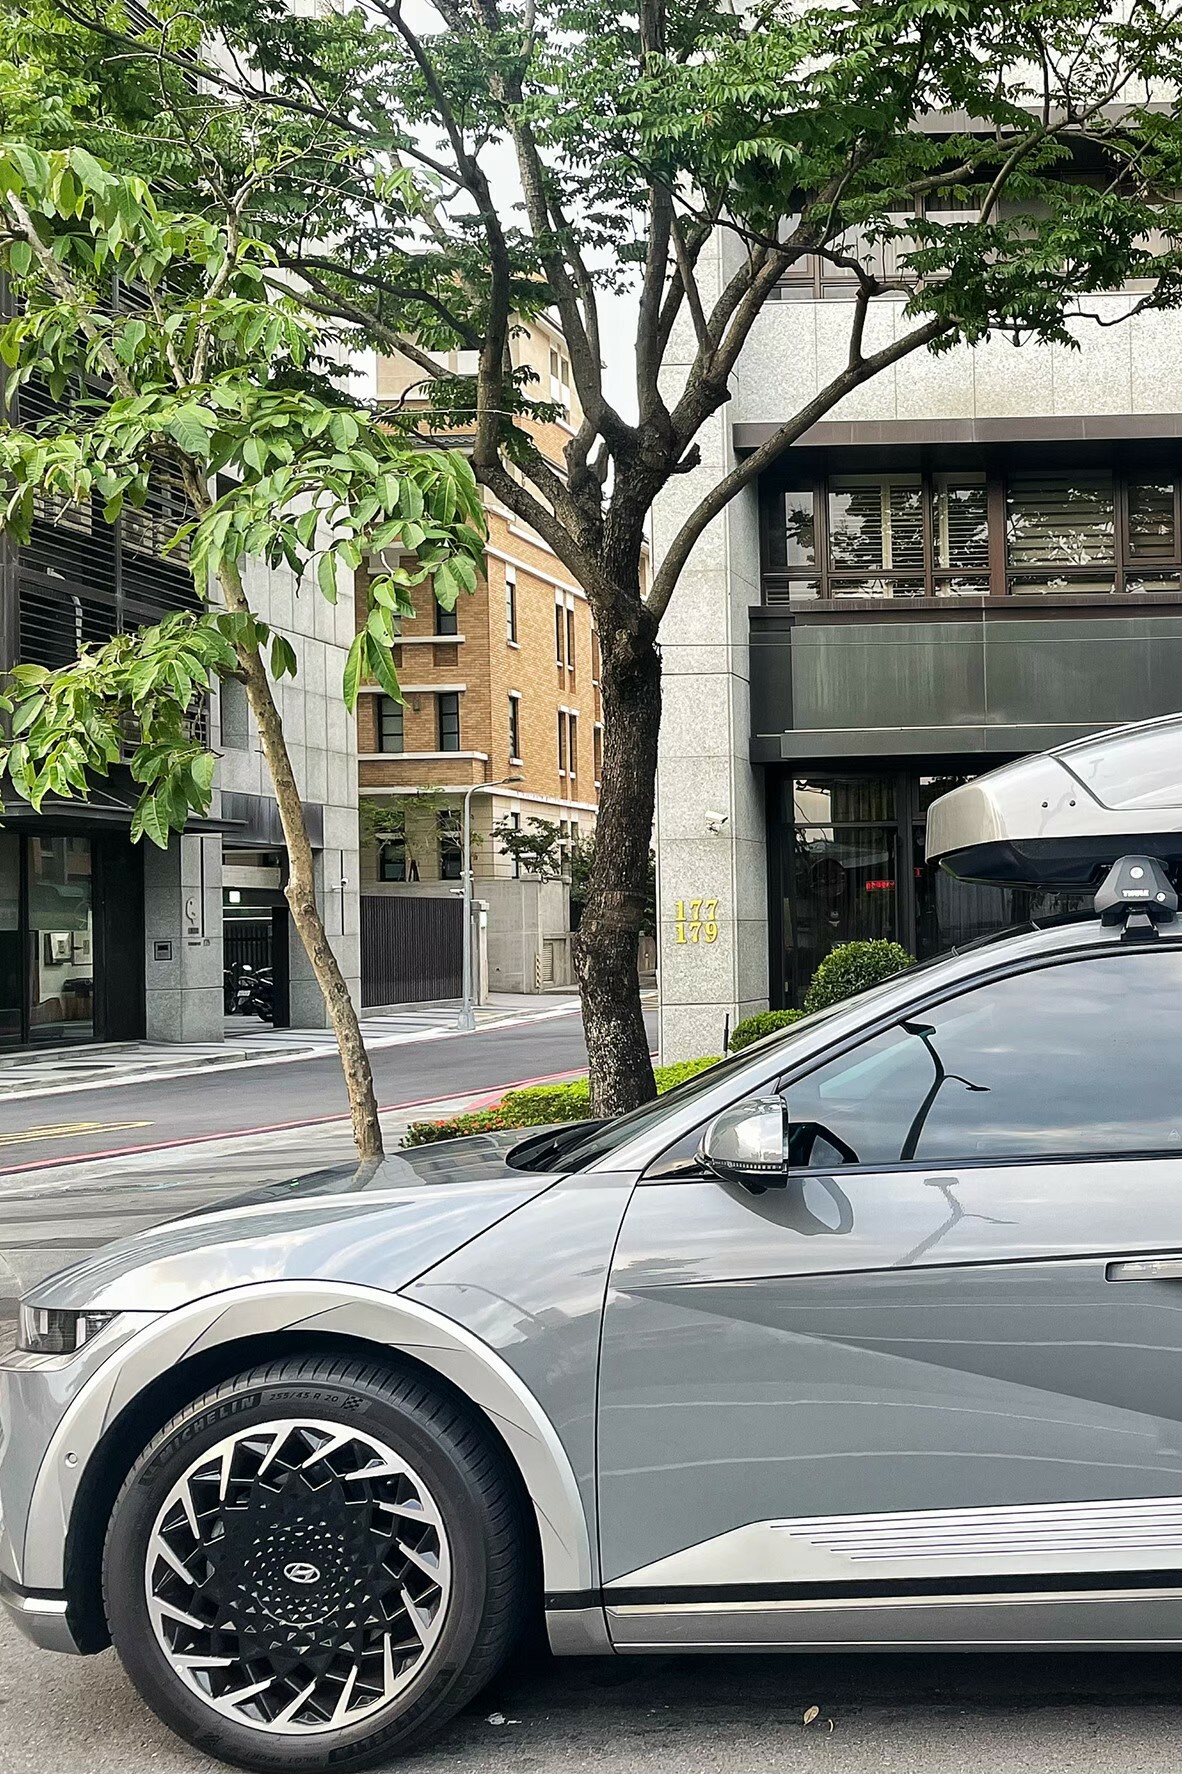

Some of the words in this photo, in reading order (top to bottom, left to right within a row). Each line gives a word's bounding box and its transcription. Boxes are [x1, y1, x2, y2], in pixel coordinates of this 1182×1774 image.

[1122, 889, 1150, 897] THULE
[674, 899, 718, 921] 177
[674, 921, 718, 944] 179
[159, 1395, 255, 1463] MICHELIN
[269, 1391, 311, 1401] 255/45
[313, 1392, 322, 1400] R
[324, 1394, 339, 1402] 20
